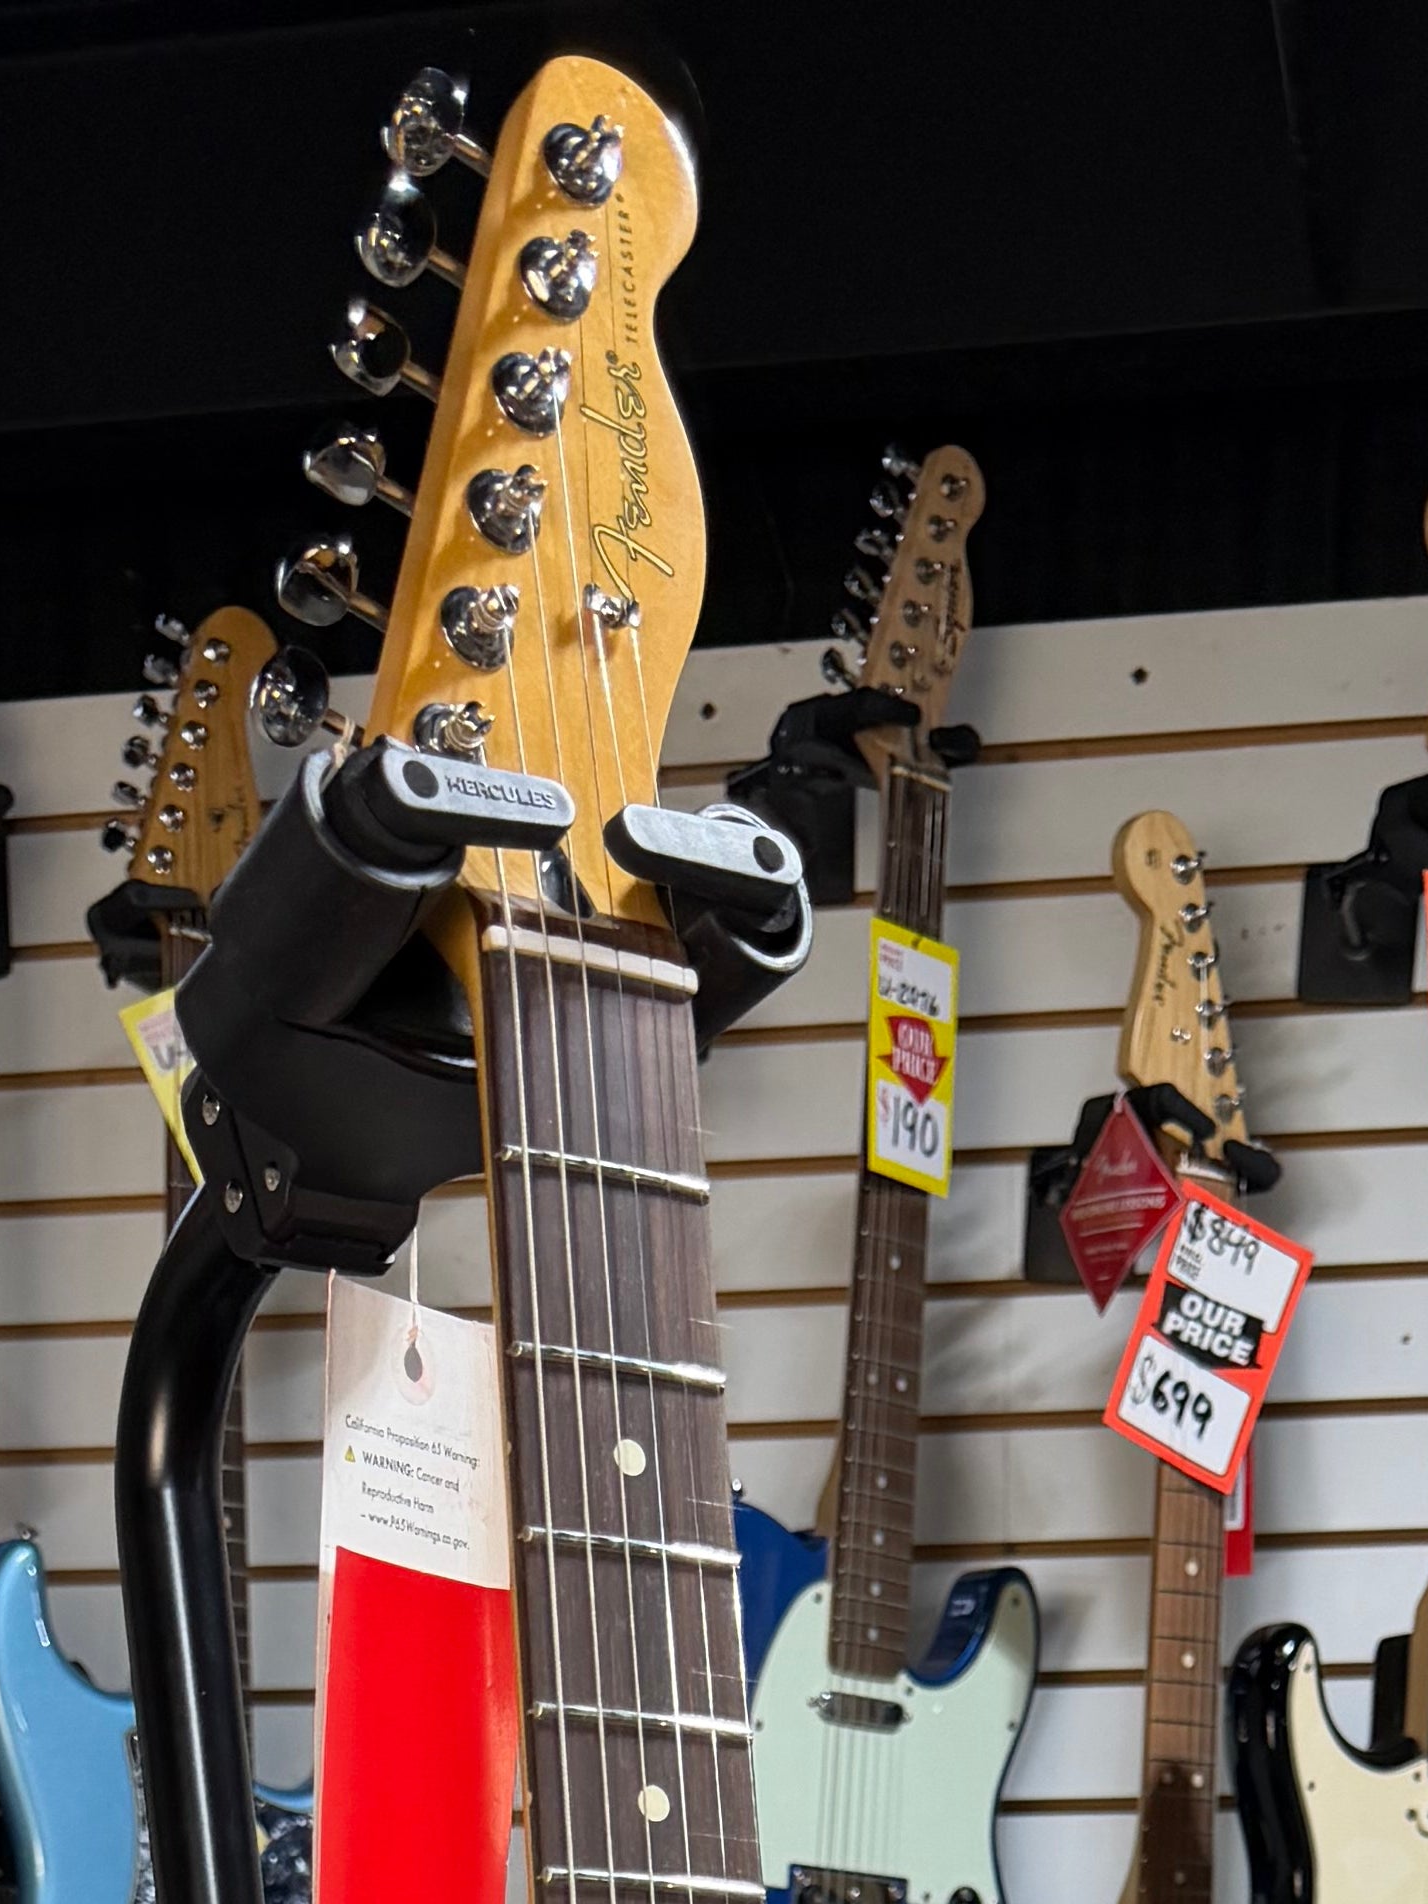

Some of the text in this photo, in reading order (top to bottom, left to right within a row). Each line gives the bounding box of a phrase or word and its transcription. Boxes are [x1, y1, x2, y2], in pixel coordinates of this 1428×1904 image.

[581, 360, 675, 601] Fender
[445, 774, 557, 810] HERCULES
[897, 1020, 935, 1057] OUR
[891, 1047, 938, 1085] PRICE
[878, 1086, 940, 1158] $190
[1185, 1202, 1261, 1275] $849
[1160, 1311, 1255, 1367] PRICE
[1180, 1293, 1247, 1337] OUR
[1130, 1352, 1214, 1439] $699
[345, 1413, 481, 1471] California Proposition 65 Warning:
[362, 1450, 460, 1493] WARNING: Cancer and
[361, 1481, 435, 1514] Reproductive Harm
